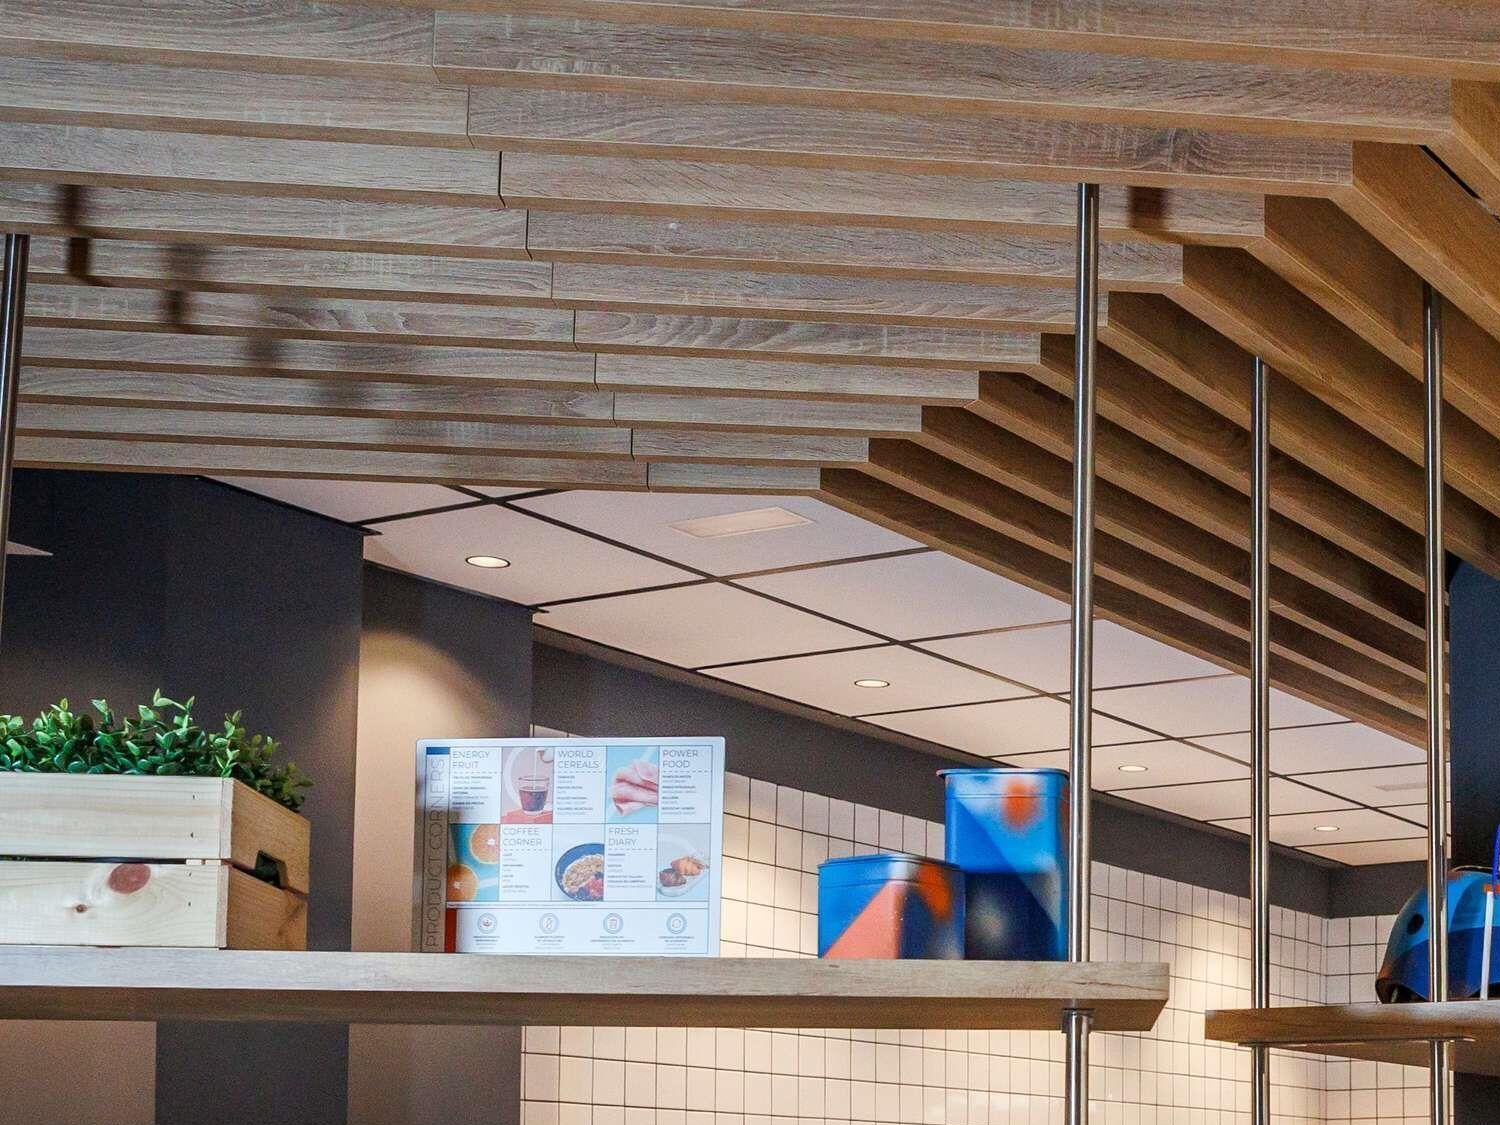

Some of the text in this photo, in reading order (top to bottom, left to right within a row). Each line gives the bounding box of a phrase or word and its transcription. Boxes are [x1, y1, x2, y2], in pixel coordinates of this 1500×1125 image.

[452, 750, 490, 759] ENERGY
[558, 750, 594, 758] WORLD
[662, 749, 698, 758] POWER
[452, 761, 479, 769] FRUIT
[557, 760, 600, 769] CEREALS
[662, 760, 690, 769] FOOD
[502, 827, 540, 836] COFFEE
[608, 827, 639, 836] FRESH
[502, 838, 543, 847] CORNER
[425, 758, 446, 948] PRODUCT CORNERS
